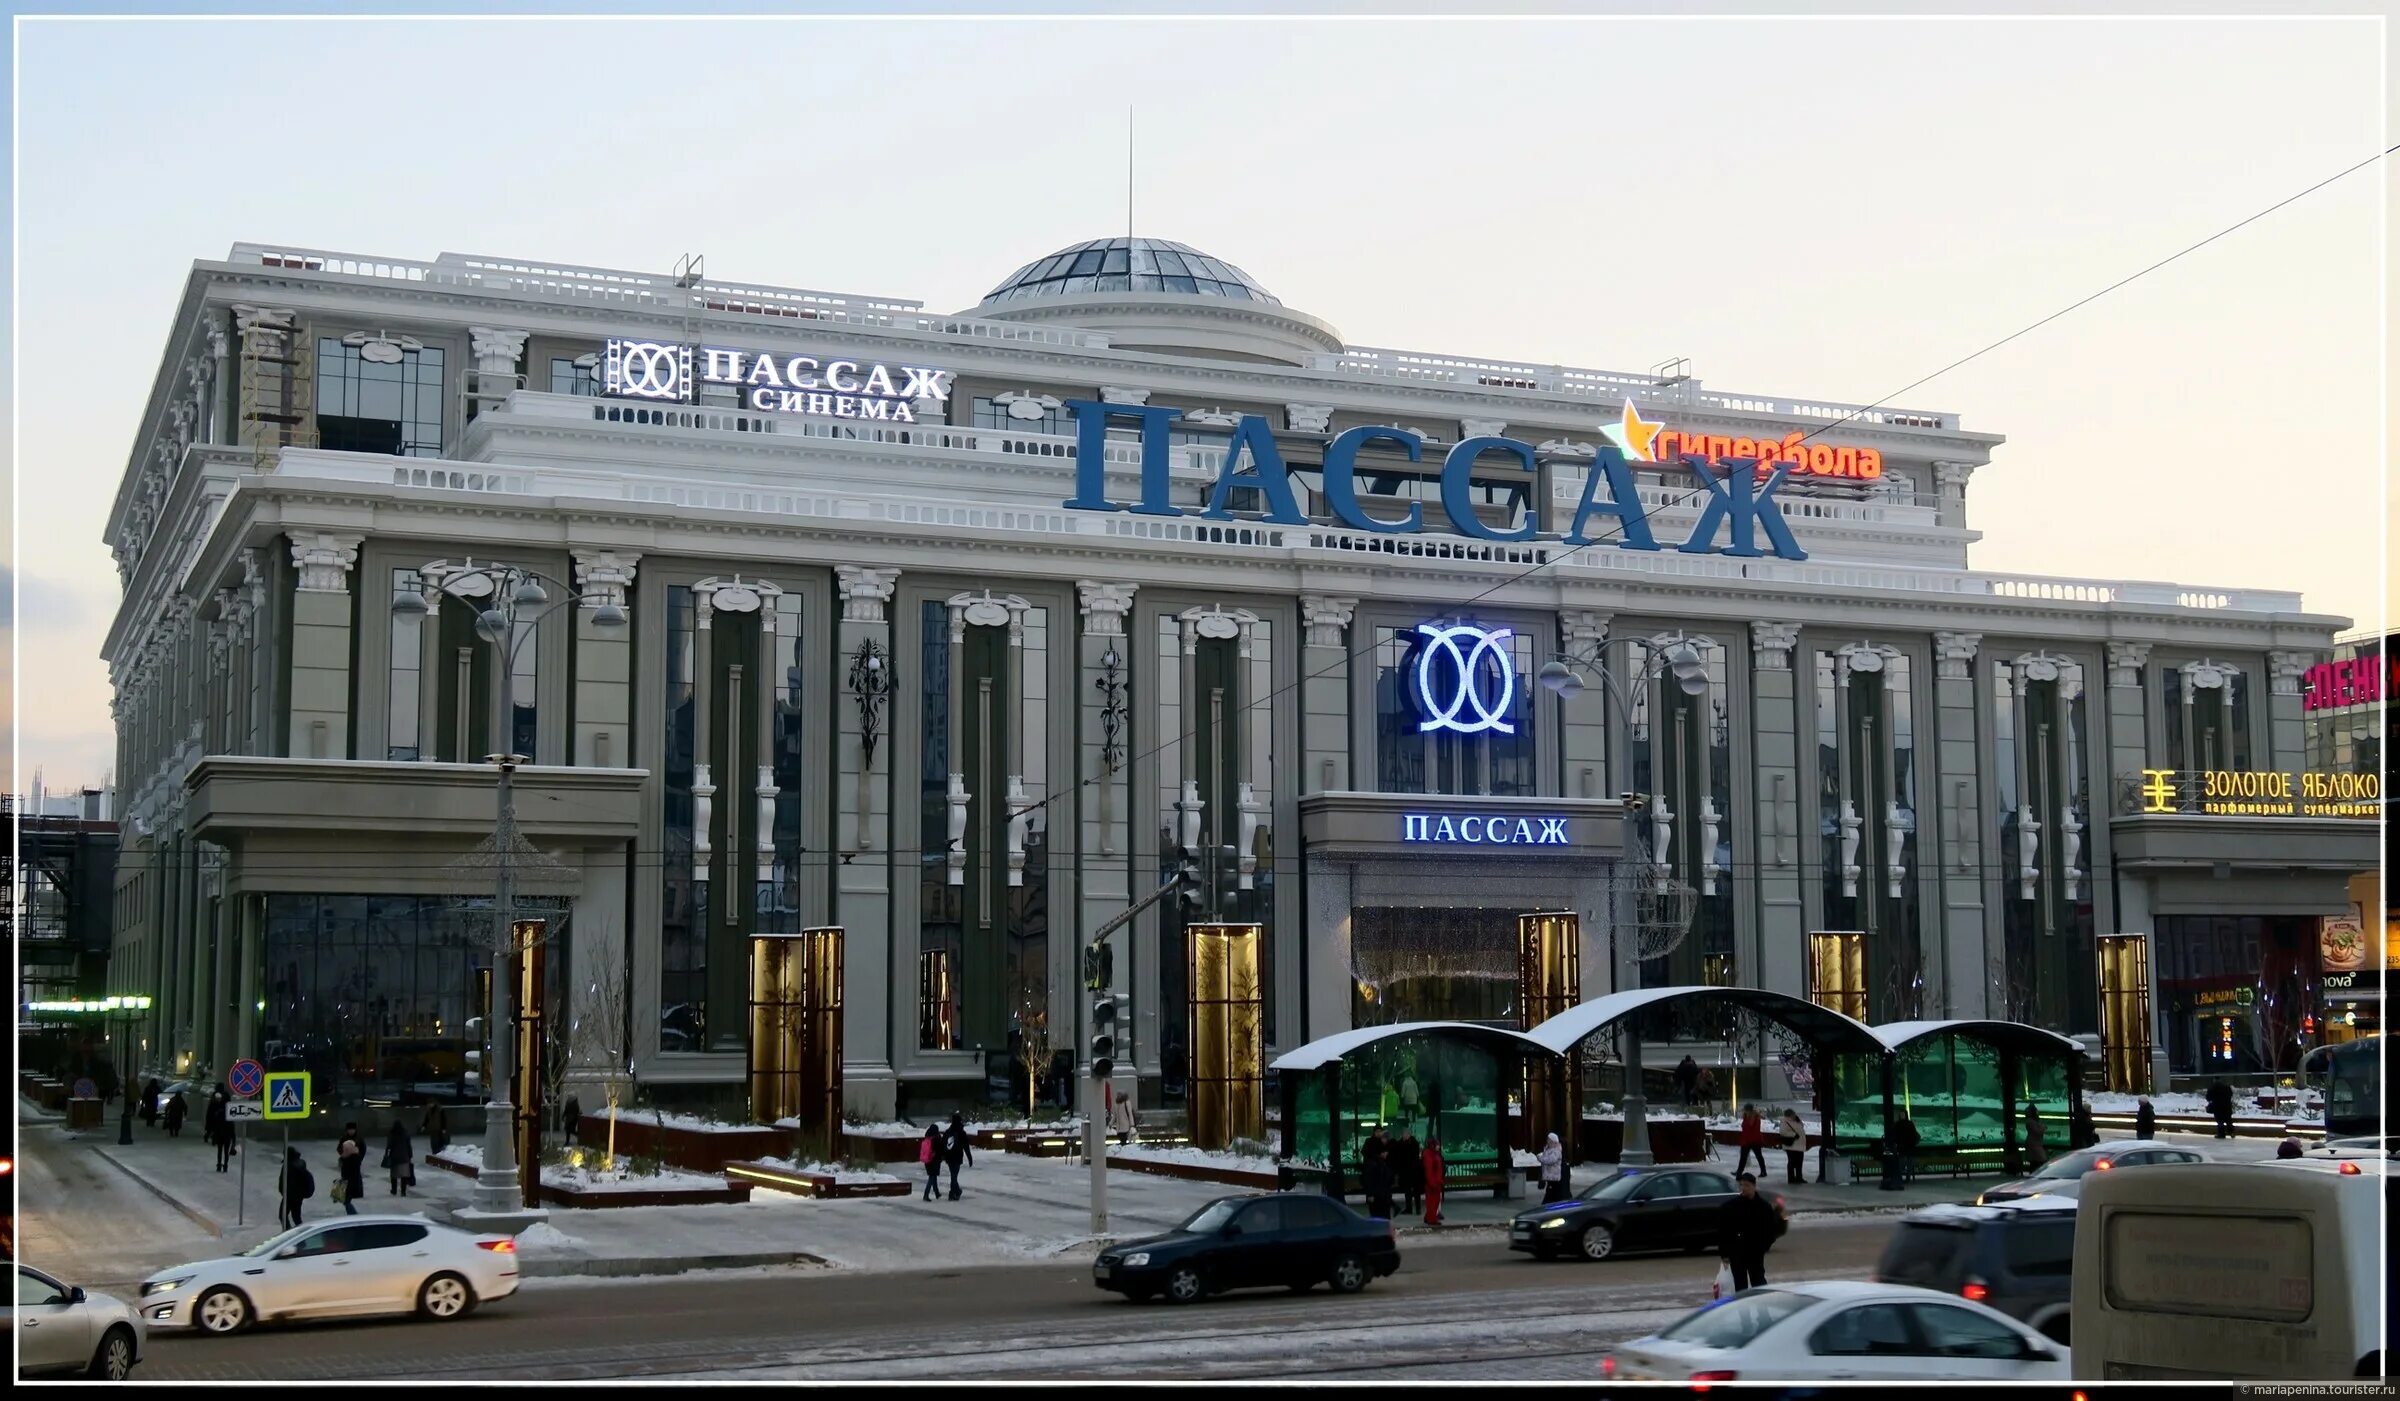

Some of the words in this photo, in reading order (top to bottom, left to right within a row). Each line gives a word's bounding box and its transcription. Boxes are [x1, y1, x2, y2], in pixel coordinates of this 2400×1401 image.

[704, 348, 947, 400] ПАССАЖ
[752, 388, 914, 422] СИНЕМА
[1656, 431, 1882, 479] гипербола
[1063, 399, 1809, 561] ПАССАЖ
[2204, 771, 2292, 798] ЗОЛОТОЕ
[2302, 773, 2379, 799] ЯБЛОКО
[2205, 801, 2294, 816] парфюмерный
[2304, 802, 2381, 817] супермаркет
[1404, 815, 1569, 844] ПАССАЖ
